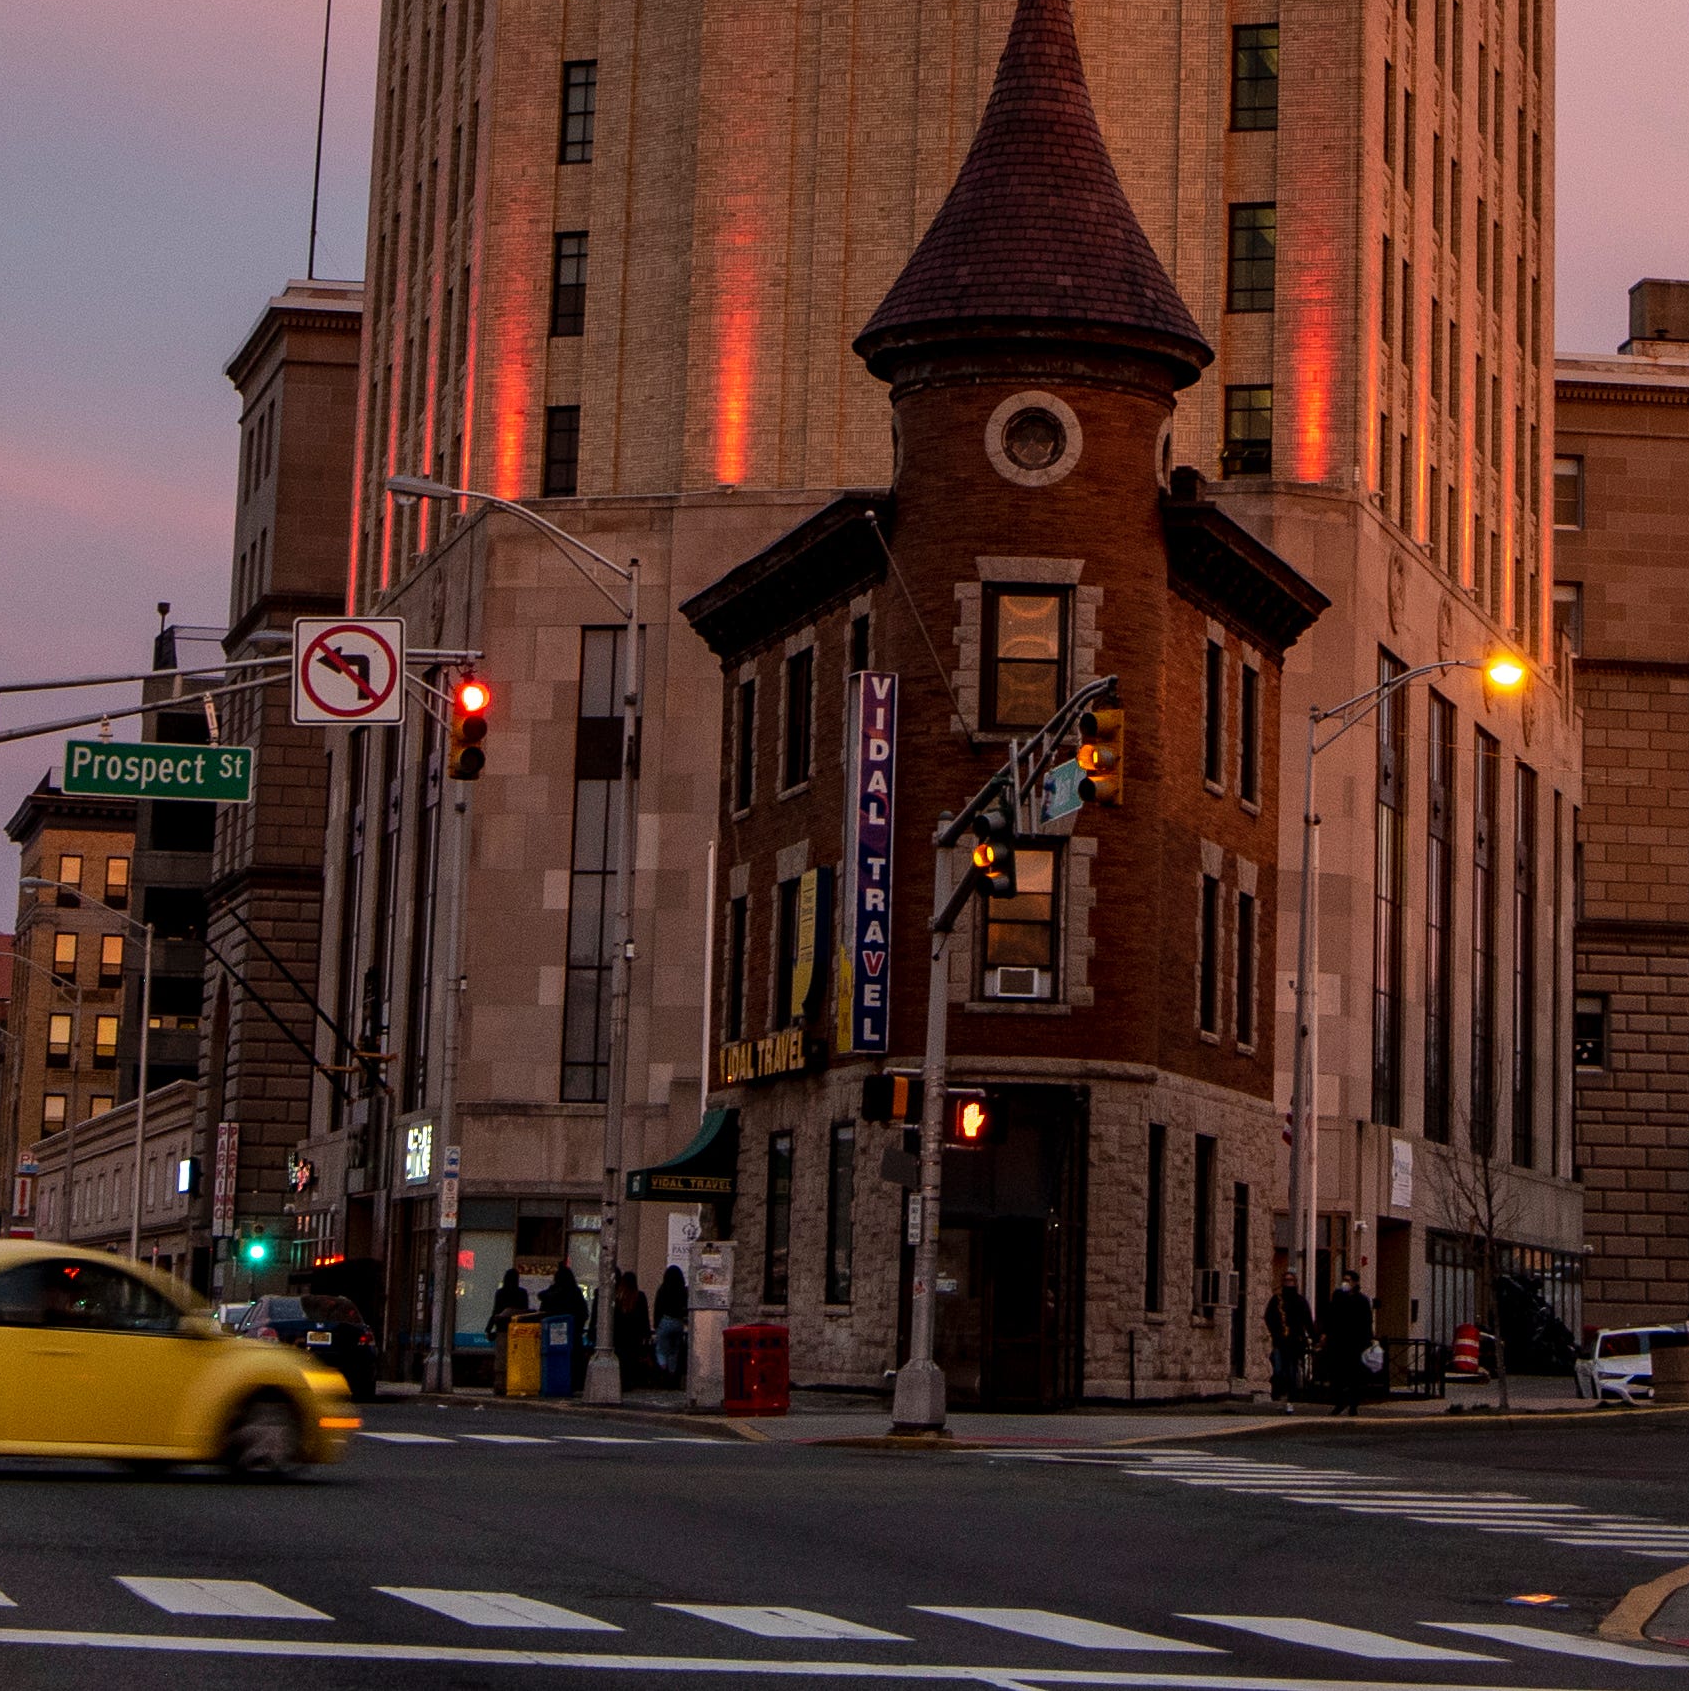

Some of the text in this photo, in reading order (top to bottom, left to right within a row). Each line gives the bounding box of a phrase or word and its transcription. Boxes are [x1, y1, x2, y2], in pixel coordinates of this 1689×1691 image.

[71, 745, 245, 790] Prospect St
[862, 676, 892, 1043] VIDAL TRAVEL
[719, 1028, 807, 1085] VIDAL TRAVEL
[651, 1177, 731, 1190] VIDAL TRAVEL
